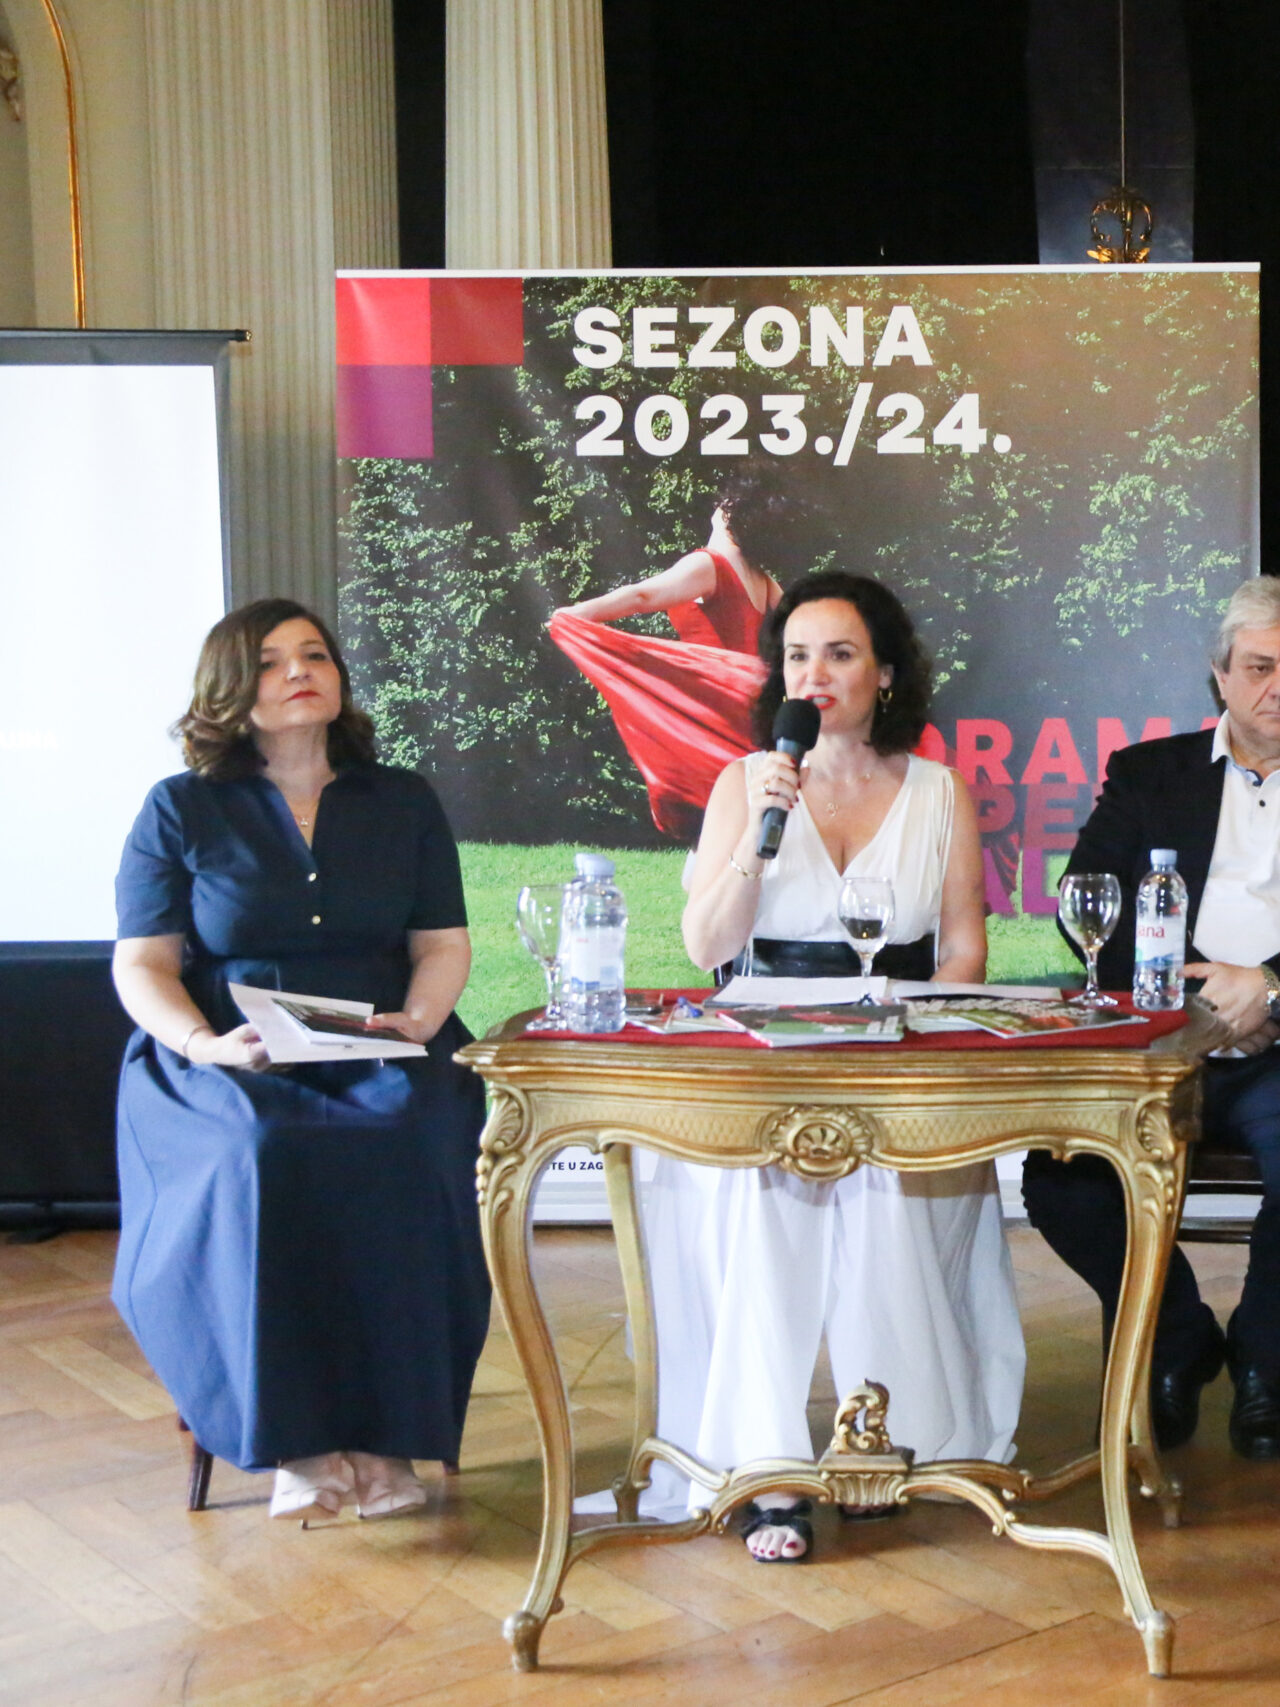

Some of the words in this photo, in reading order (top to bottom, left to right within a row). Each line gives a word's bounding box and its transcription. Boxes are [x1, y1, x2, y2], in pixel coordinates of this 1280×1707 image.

[573, 305, 934, 370] SEZONA
[574, 381, 1012, 467] 2023./24.
[568, 1162, 577, 1171] U
